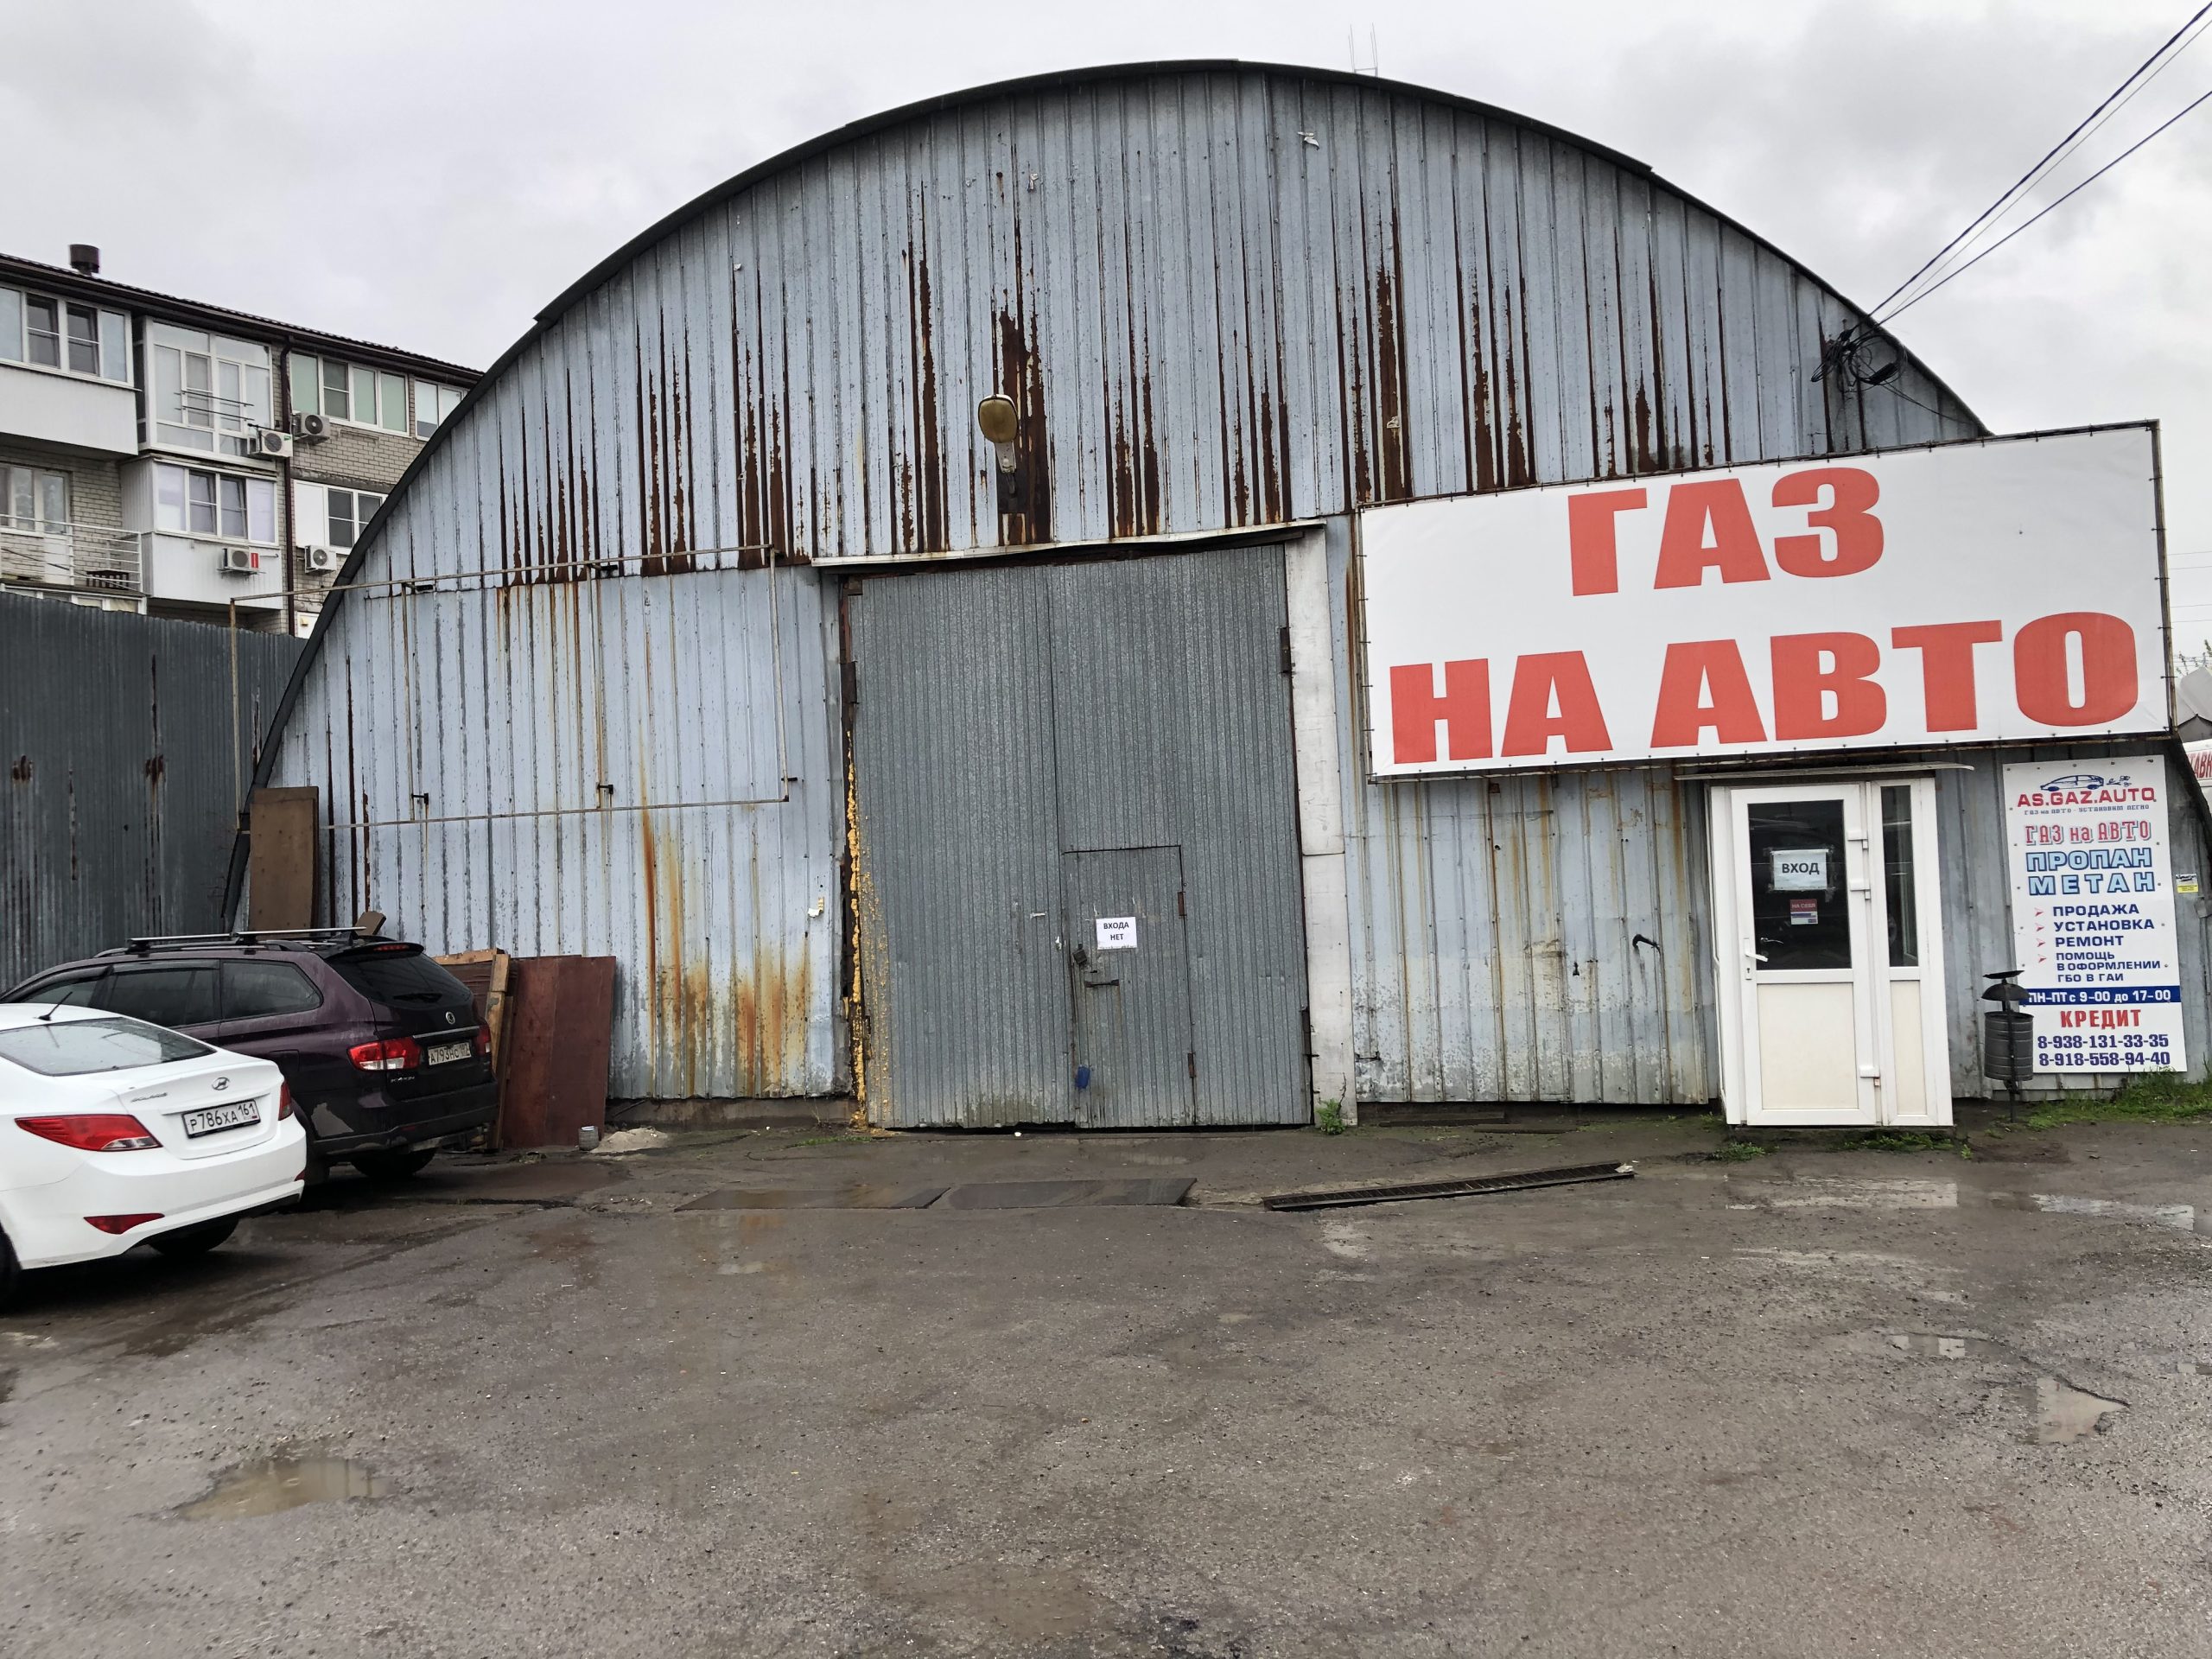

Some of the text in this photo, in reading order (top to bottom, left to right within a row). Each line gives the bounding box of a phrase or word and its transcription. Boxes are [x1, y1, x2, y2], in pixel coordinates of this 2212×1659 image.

[1568, 467, 1884, 596] ГАЗ
[1389, 611, 2139, 765] НА АВТО
[2017, 787, 2155, 807] AS.GAZ.AUTO
[2024, 820, 2152, 846] ГАЗ на АВТО
[2025, 848, 2152, 872] ПРОПАН
[1782, 862, 1820, 875] ВХОД
[2028, 871, 2155, 896] МЕТАН
[2053, 904, 2139, 918] ПРОДАЖА
[2053, 919, 2155, 932] УСТАНОВКА
[2055, 935, 2124, 948] РЕМОНТ
[2056, 951, 2115, 962] ПОМОЩЬ
[2056, 961, 2161, 971] В ОФОРМЛЕНИИ
[2057, 974, 2082, 982] ГБО
[2099, 973, 2124, 982] ГАИ
[2028, 989, 2171, 1003] ПН-ПТ с 9-00 до 17-00
[2060, 1009, 2141, 1030] КРЕДИТ
[2037, 1033, 2169, 1049] 8-938-131-33-35
[2039, 1052, 2171, 1066] 8-918-558-94-40
